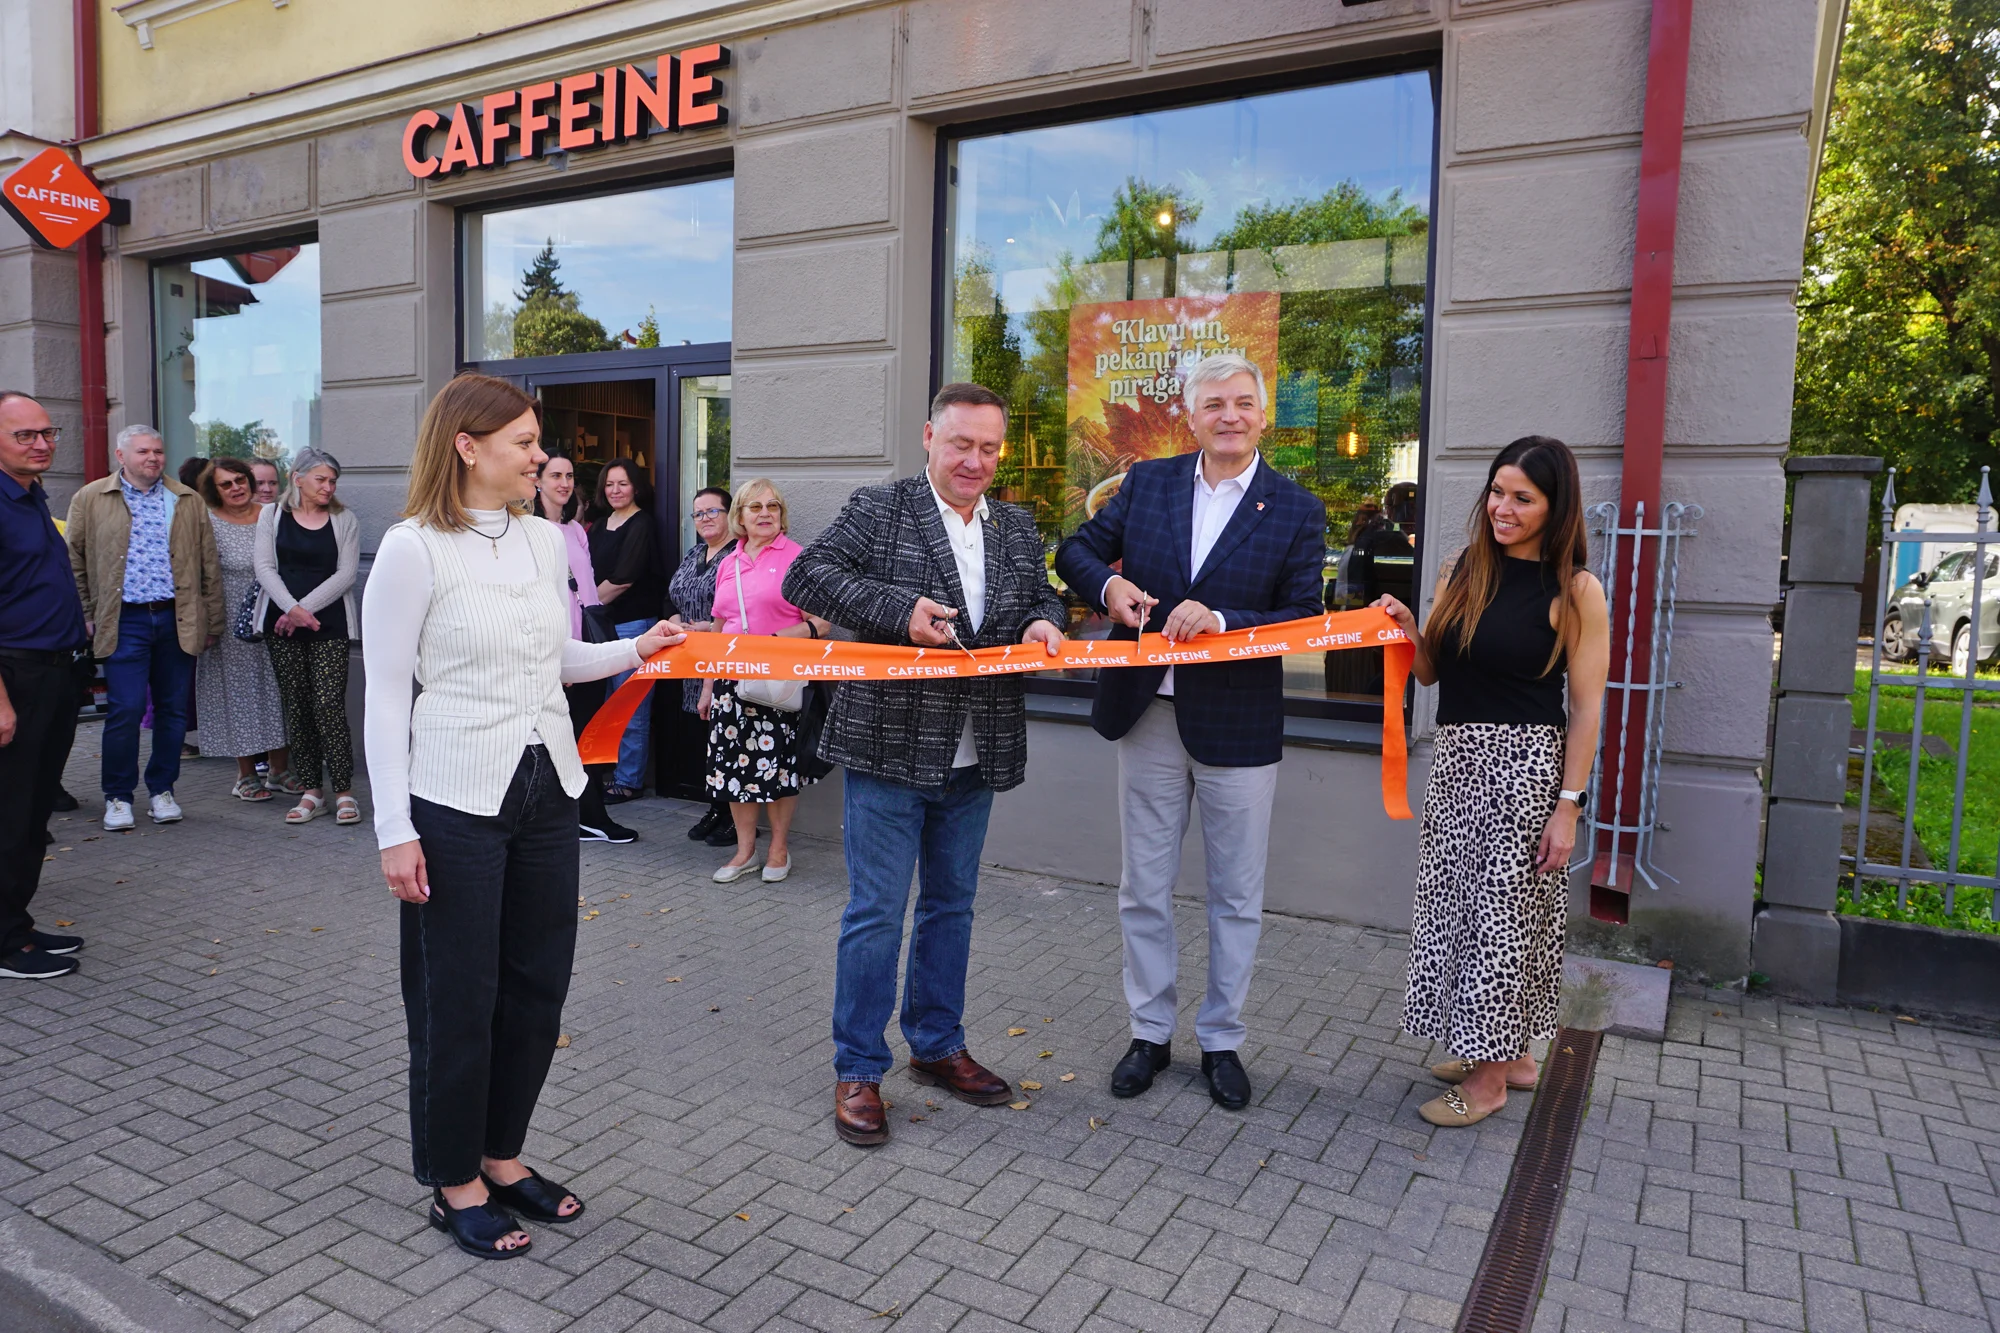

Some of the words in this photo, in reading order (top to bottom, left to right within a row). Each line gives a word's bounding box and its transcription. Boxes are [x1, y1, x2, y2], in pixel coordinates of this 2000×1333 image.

[402, 43, 720, 178] CAFFEINE
[13, 183, 100, 213] CAFFEINE
[1112, 317, 1186, 351] Kļavu
[1192, 320, 1230, 344] un
[1108, 374, 1181, 404] pīrāga
[694, 660, 771, 675] CAFFEINE
[792, 664, 866, 677] CAFFEINE
[887, 666, 958, 677] CAFFEINE
[977, 660, 1046, 674] CAFFEINE
[1064, 656, 1130, 666] CAFFEINE
[1147, 650, 1212, 664] CAFFEINE
[1228, 642, 1291, 658] CAFFEINE
[1306, 631, 1363, 648] CAFFEINE
